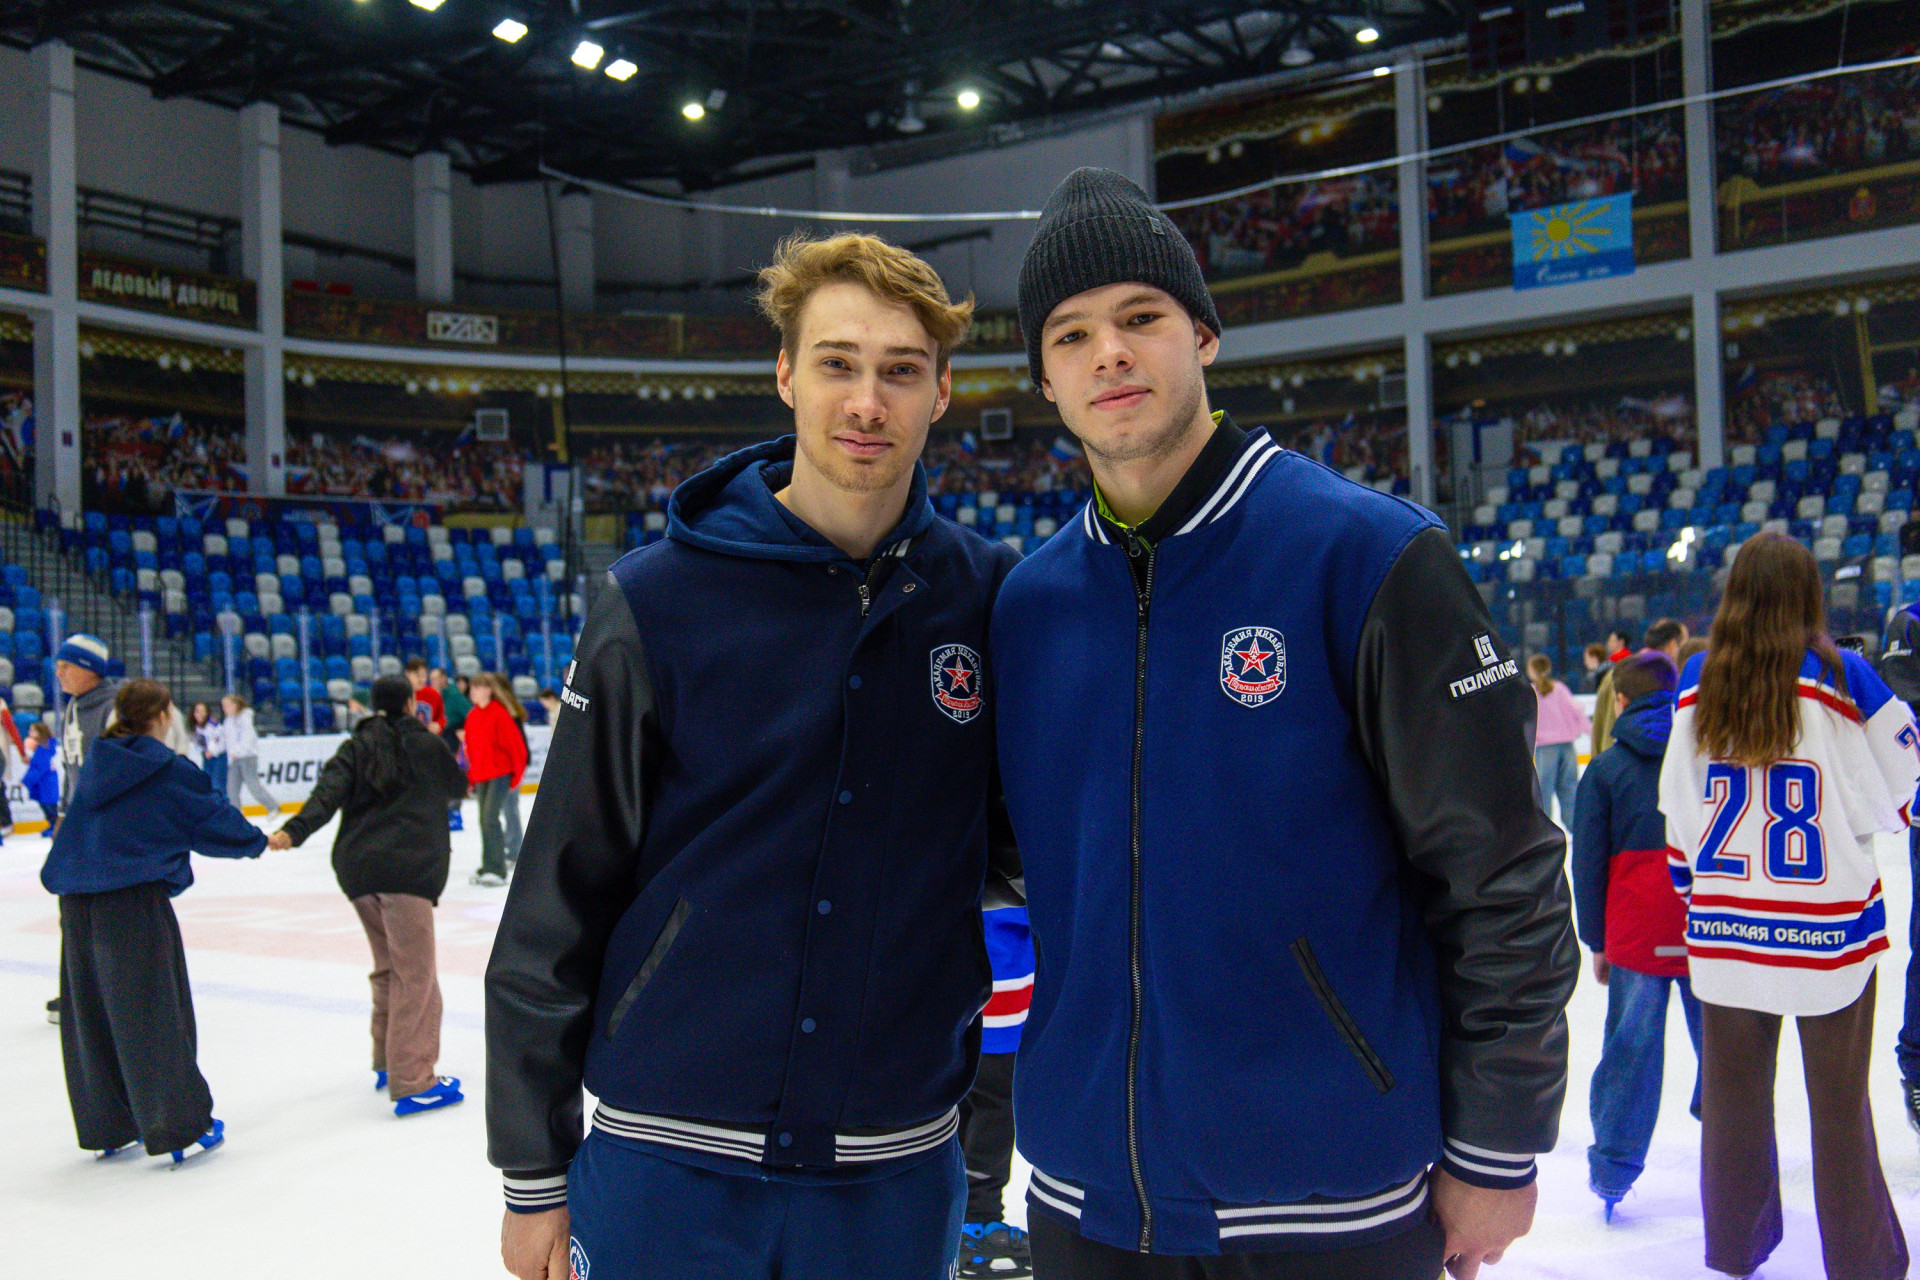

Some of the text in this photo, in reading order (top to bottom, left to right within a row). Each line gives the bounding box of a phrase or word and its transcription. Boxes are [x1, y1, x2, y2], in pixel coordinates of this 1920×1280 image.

[1240, 694, 1264, 703] 2019
[952, 710, 970, 719] 2019
[1694, 757, 1828, 886] 28
[1691, 920, 1769, 942] ТУЛЬСКАЯ
